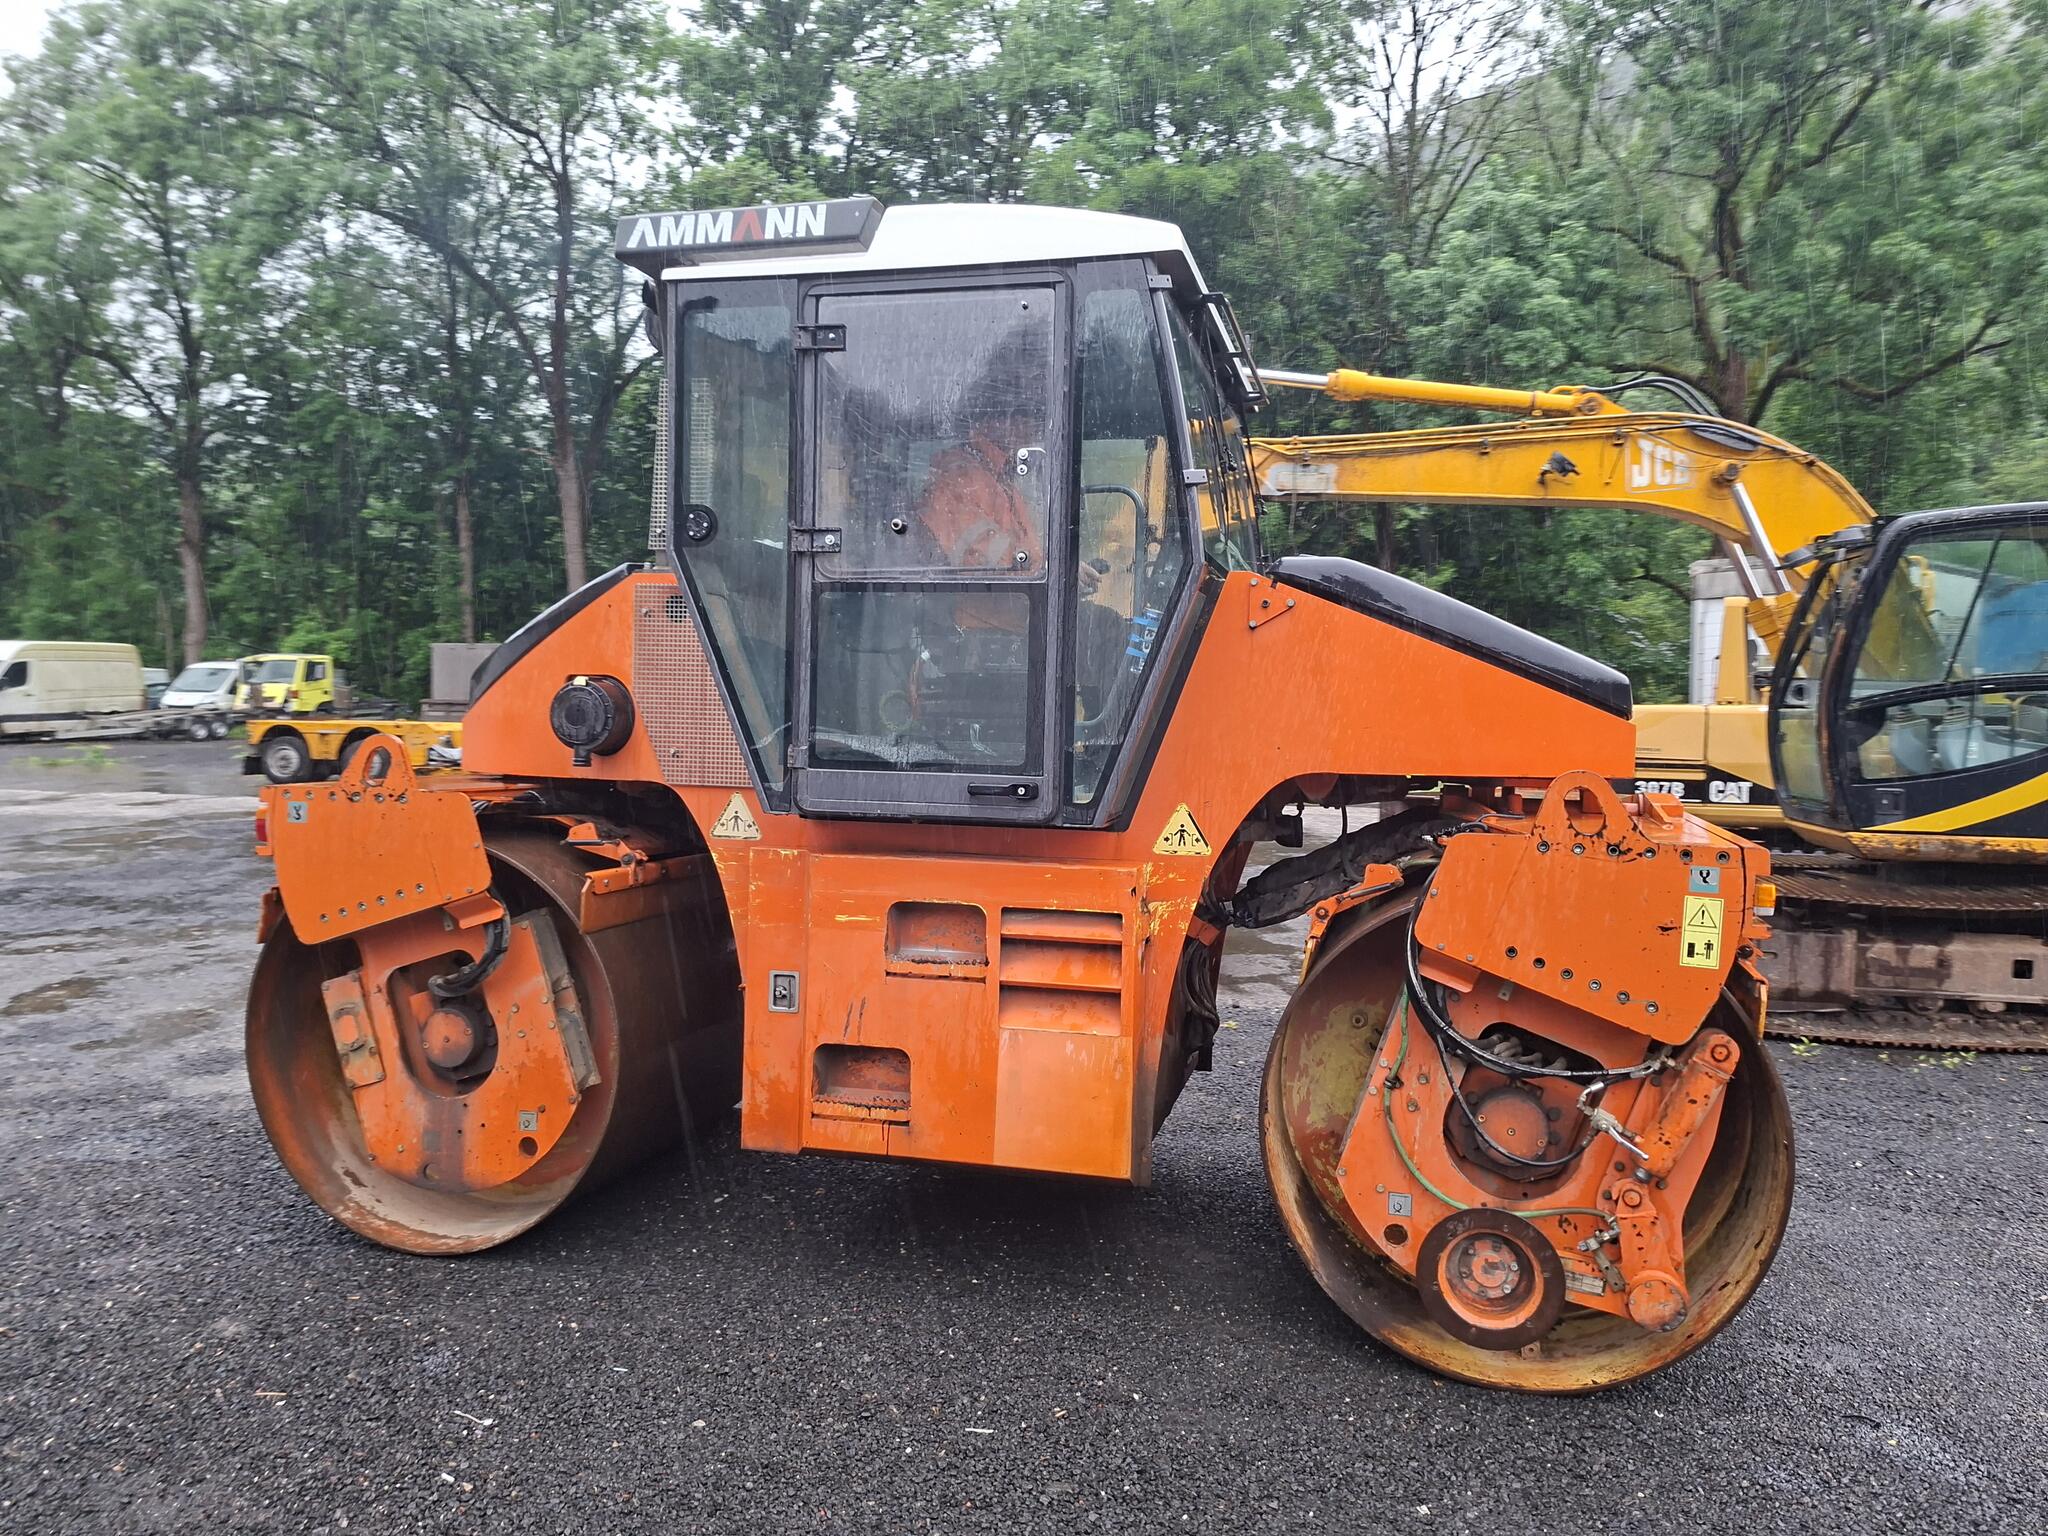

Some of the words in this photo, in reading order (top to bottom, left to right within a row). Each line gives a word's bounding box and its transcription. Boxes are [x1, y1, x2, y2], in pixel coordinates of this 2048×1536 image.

[627, 204, 827, 248] AMMANN
[1631, 437, 1690, 488] JCB
[1708, 780, 1753, 803] CAT
